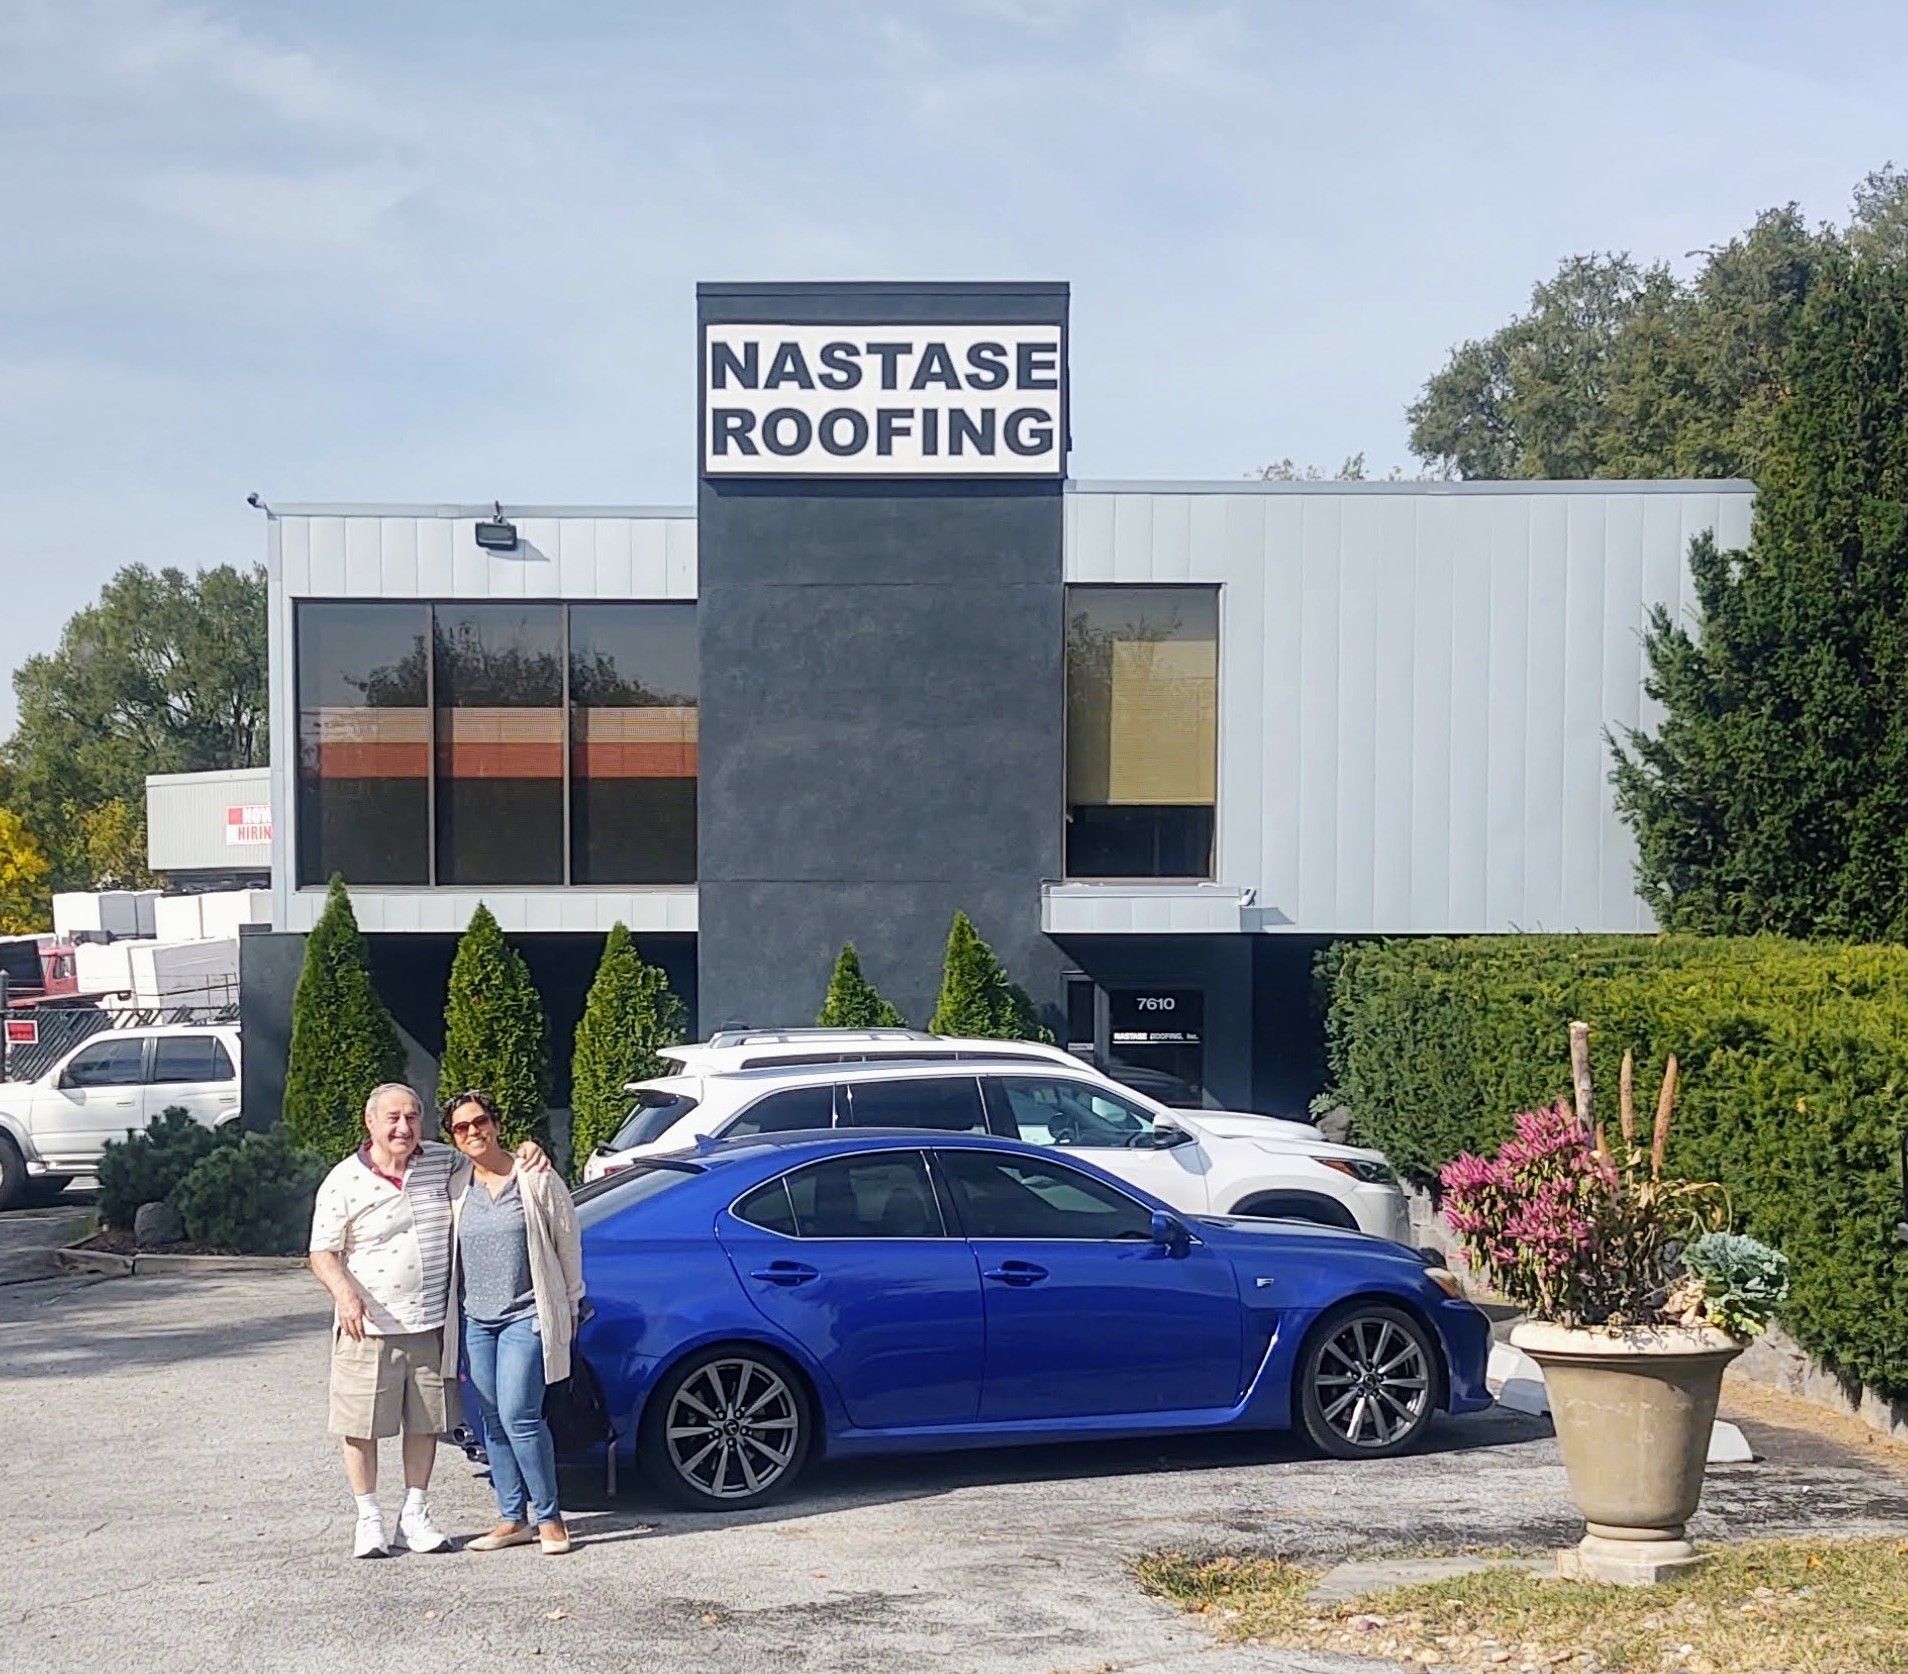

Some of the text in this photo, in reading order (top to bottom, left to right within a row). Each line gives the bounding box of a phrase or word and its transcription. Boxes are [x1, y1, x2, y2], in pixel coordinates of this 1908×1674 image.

[711, 341, 1058, 391] NASTASE
[712, 408, 1054, 456] ROOFING
[237, 825, 272, 840] HIRIN
[1136, 997, 1175, 1011] 7610
